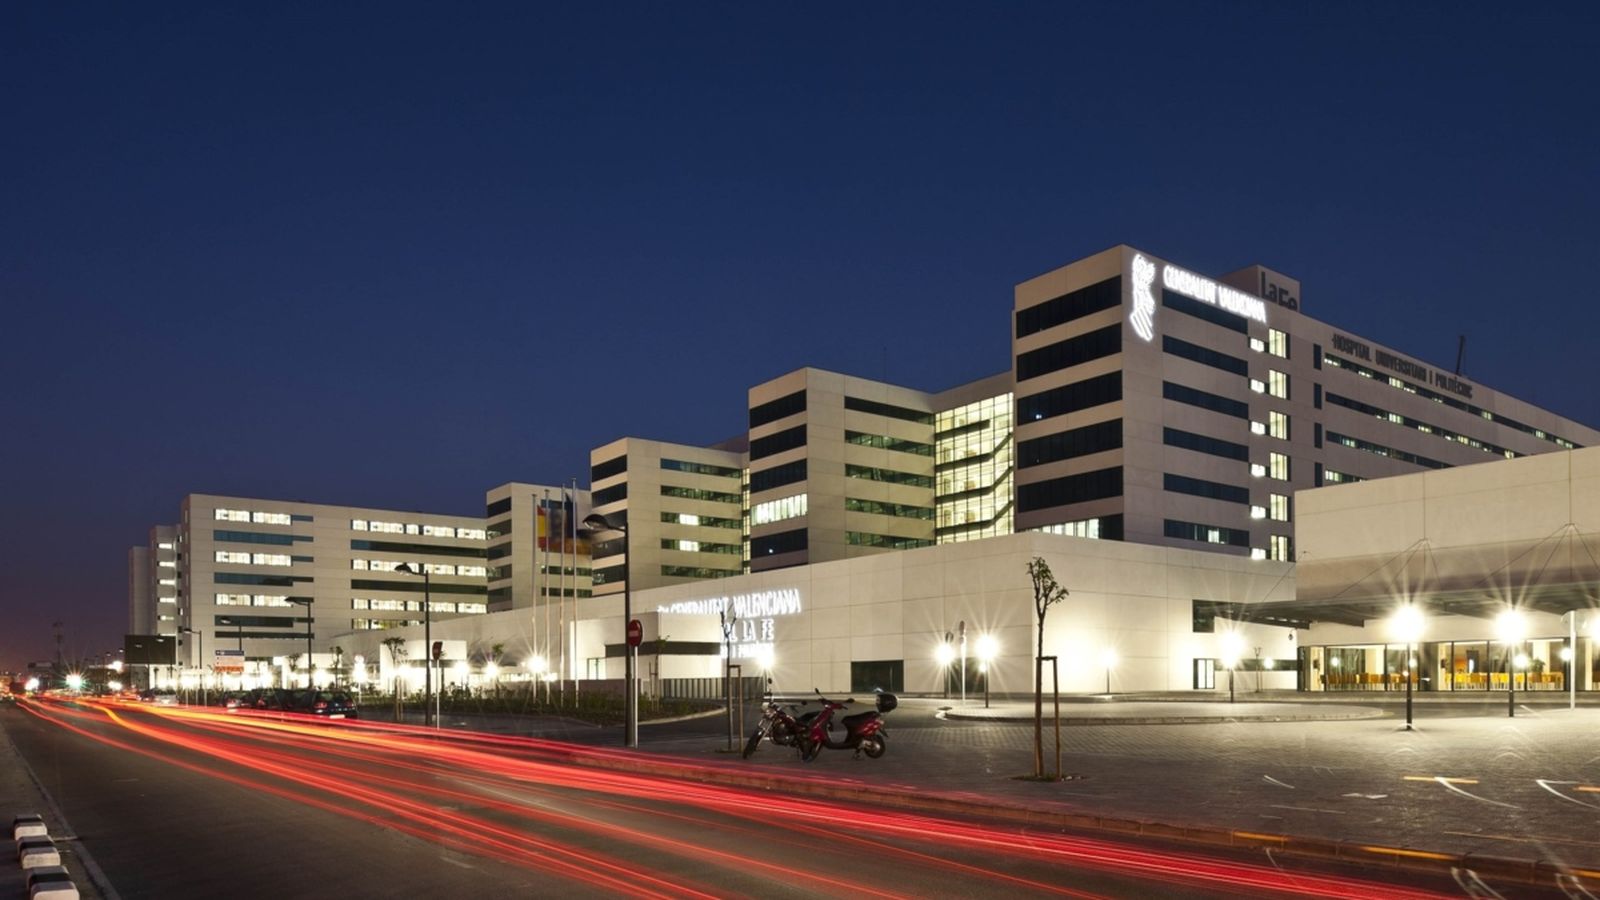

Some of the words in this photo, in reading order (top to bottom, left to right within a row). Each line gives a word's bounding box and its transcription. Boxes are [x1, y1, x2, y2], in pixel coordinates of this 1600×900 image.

[1332, 333, 1372, 362] HOSPITAL
[733, 588, 802, 618] VALENCIANA
[743, 620, 756, 641] LA
